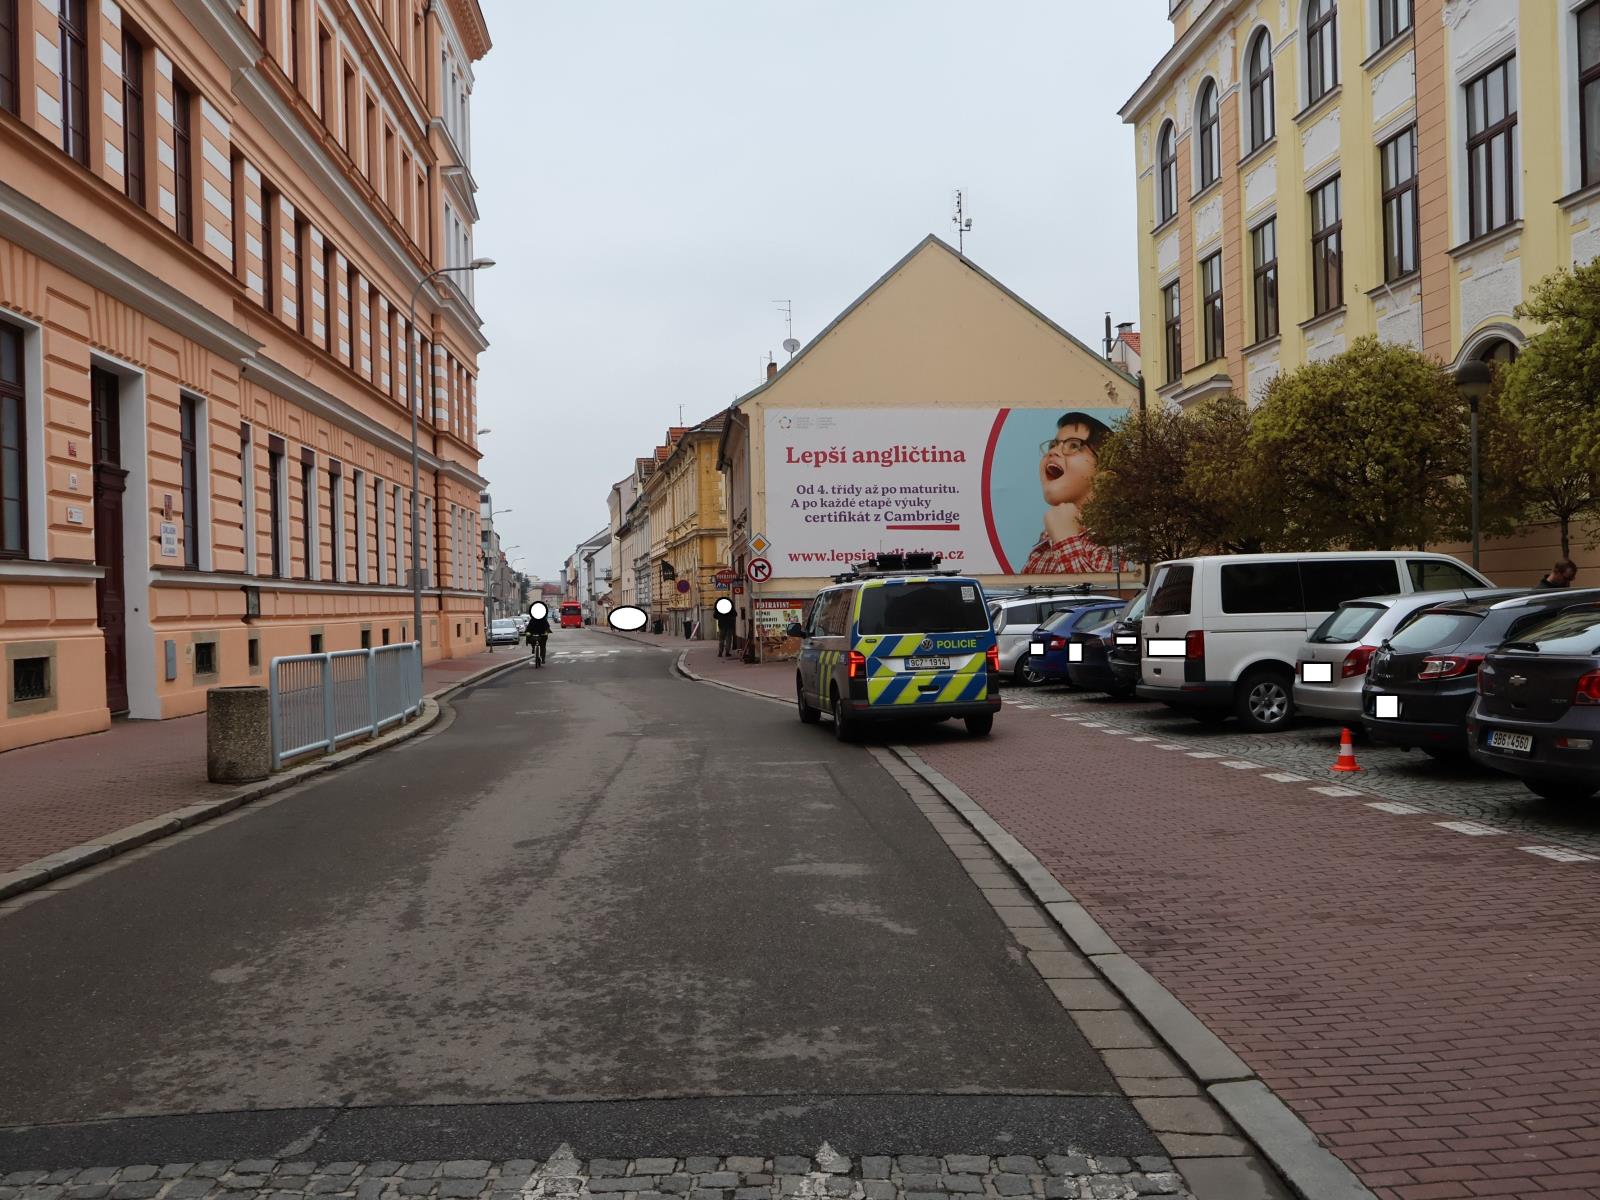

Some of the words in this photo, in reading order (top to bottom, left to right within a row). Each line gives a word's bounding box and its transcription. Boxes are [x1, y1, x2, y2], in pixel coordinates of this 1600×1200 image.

[785, 446, 847, 468] Lepší
[852, 445, 966, 467] angličtina
[796, 484, 814, 495] Od
[817, 485, 829, 495] 4.
[831, 484, 862, 497] třídy
[865, 484, 879, 495] až
[881, 486, 897, 496] po
[900, 483, 960, 494] maturitu.
[790, 498, 800, 508] A
[802, 500, 818, 510] po
[820, 498, 856, 508] každé
[858, 498, 892, 509] etapě
[894, 497, 931, 509] výuky
[804, 511, 871, 523] certifikát
[873, 513, 881, 522] z
[883, 510, 960, 523] Cambridge
[936, 640, 977, 649] POLICIE
[930, 658, 946, 666] 1914
[1510, 735, 1529, 750] 4560
